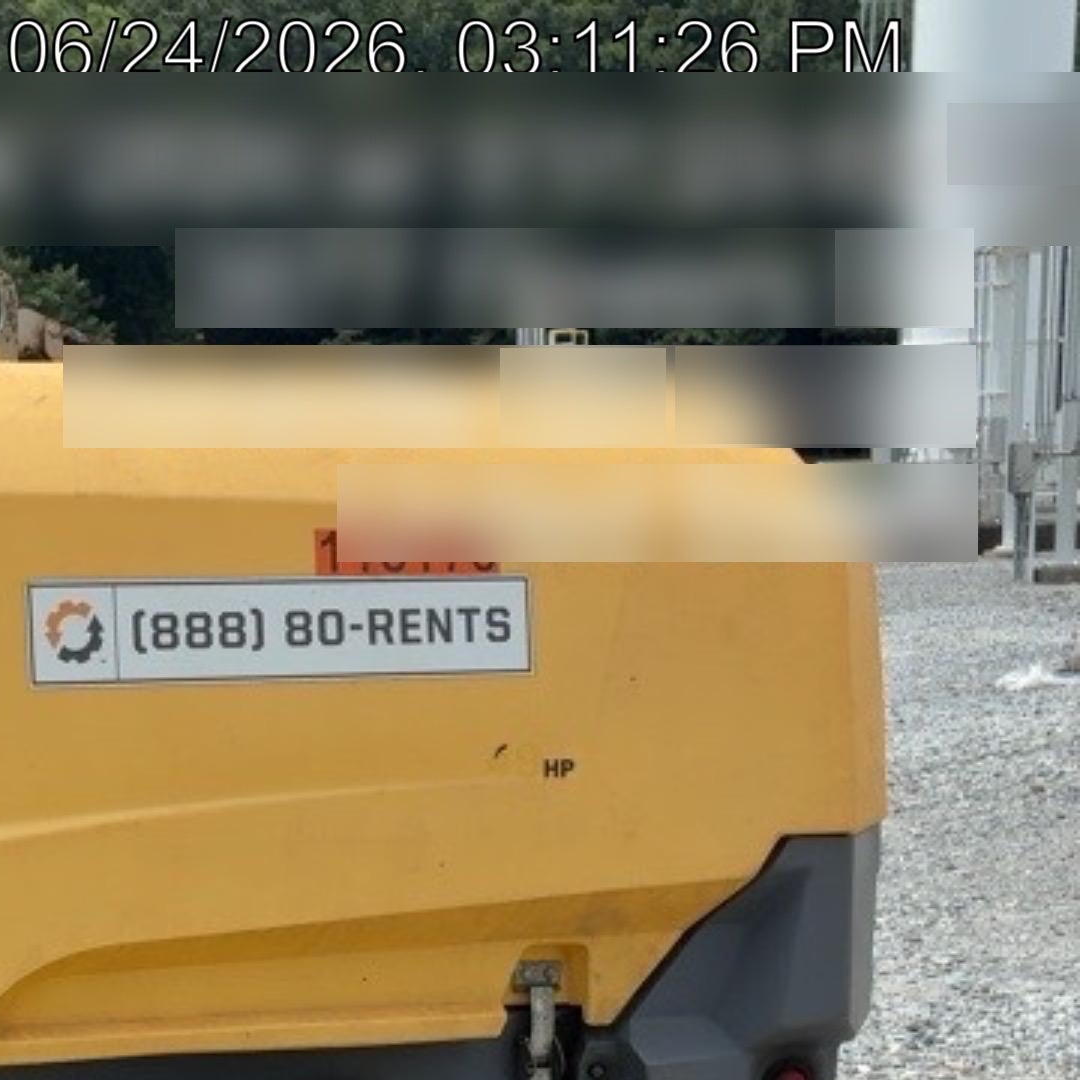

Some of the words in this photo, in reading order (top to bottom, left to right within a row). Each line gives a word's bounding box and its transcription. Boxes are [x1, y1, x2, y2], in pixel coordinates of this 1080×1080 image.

[132, 609, 265, 654] (888)
[285, 606, 512, 647] 80-RENTS
[543, 758, 574, 778] HP
